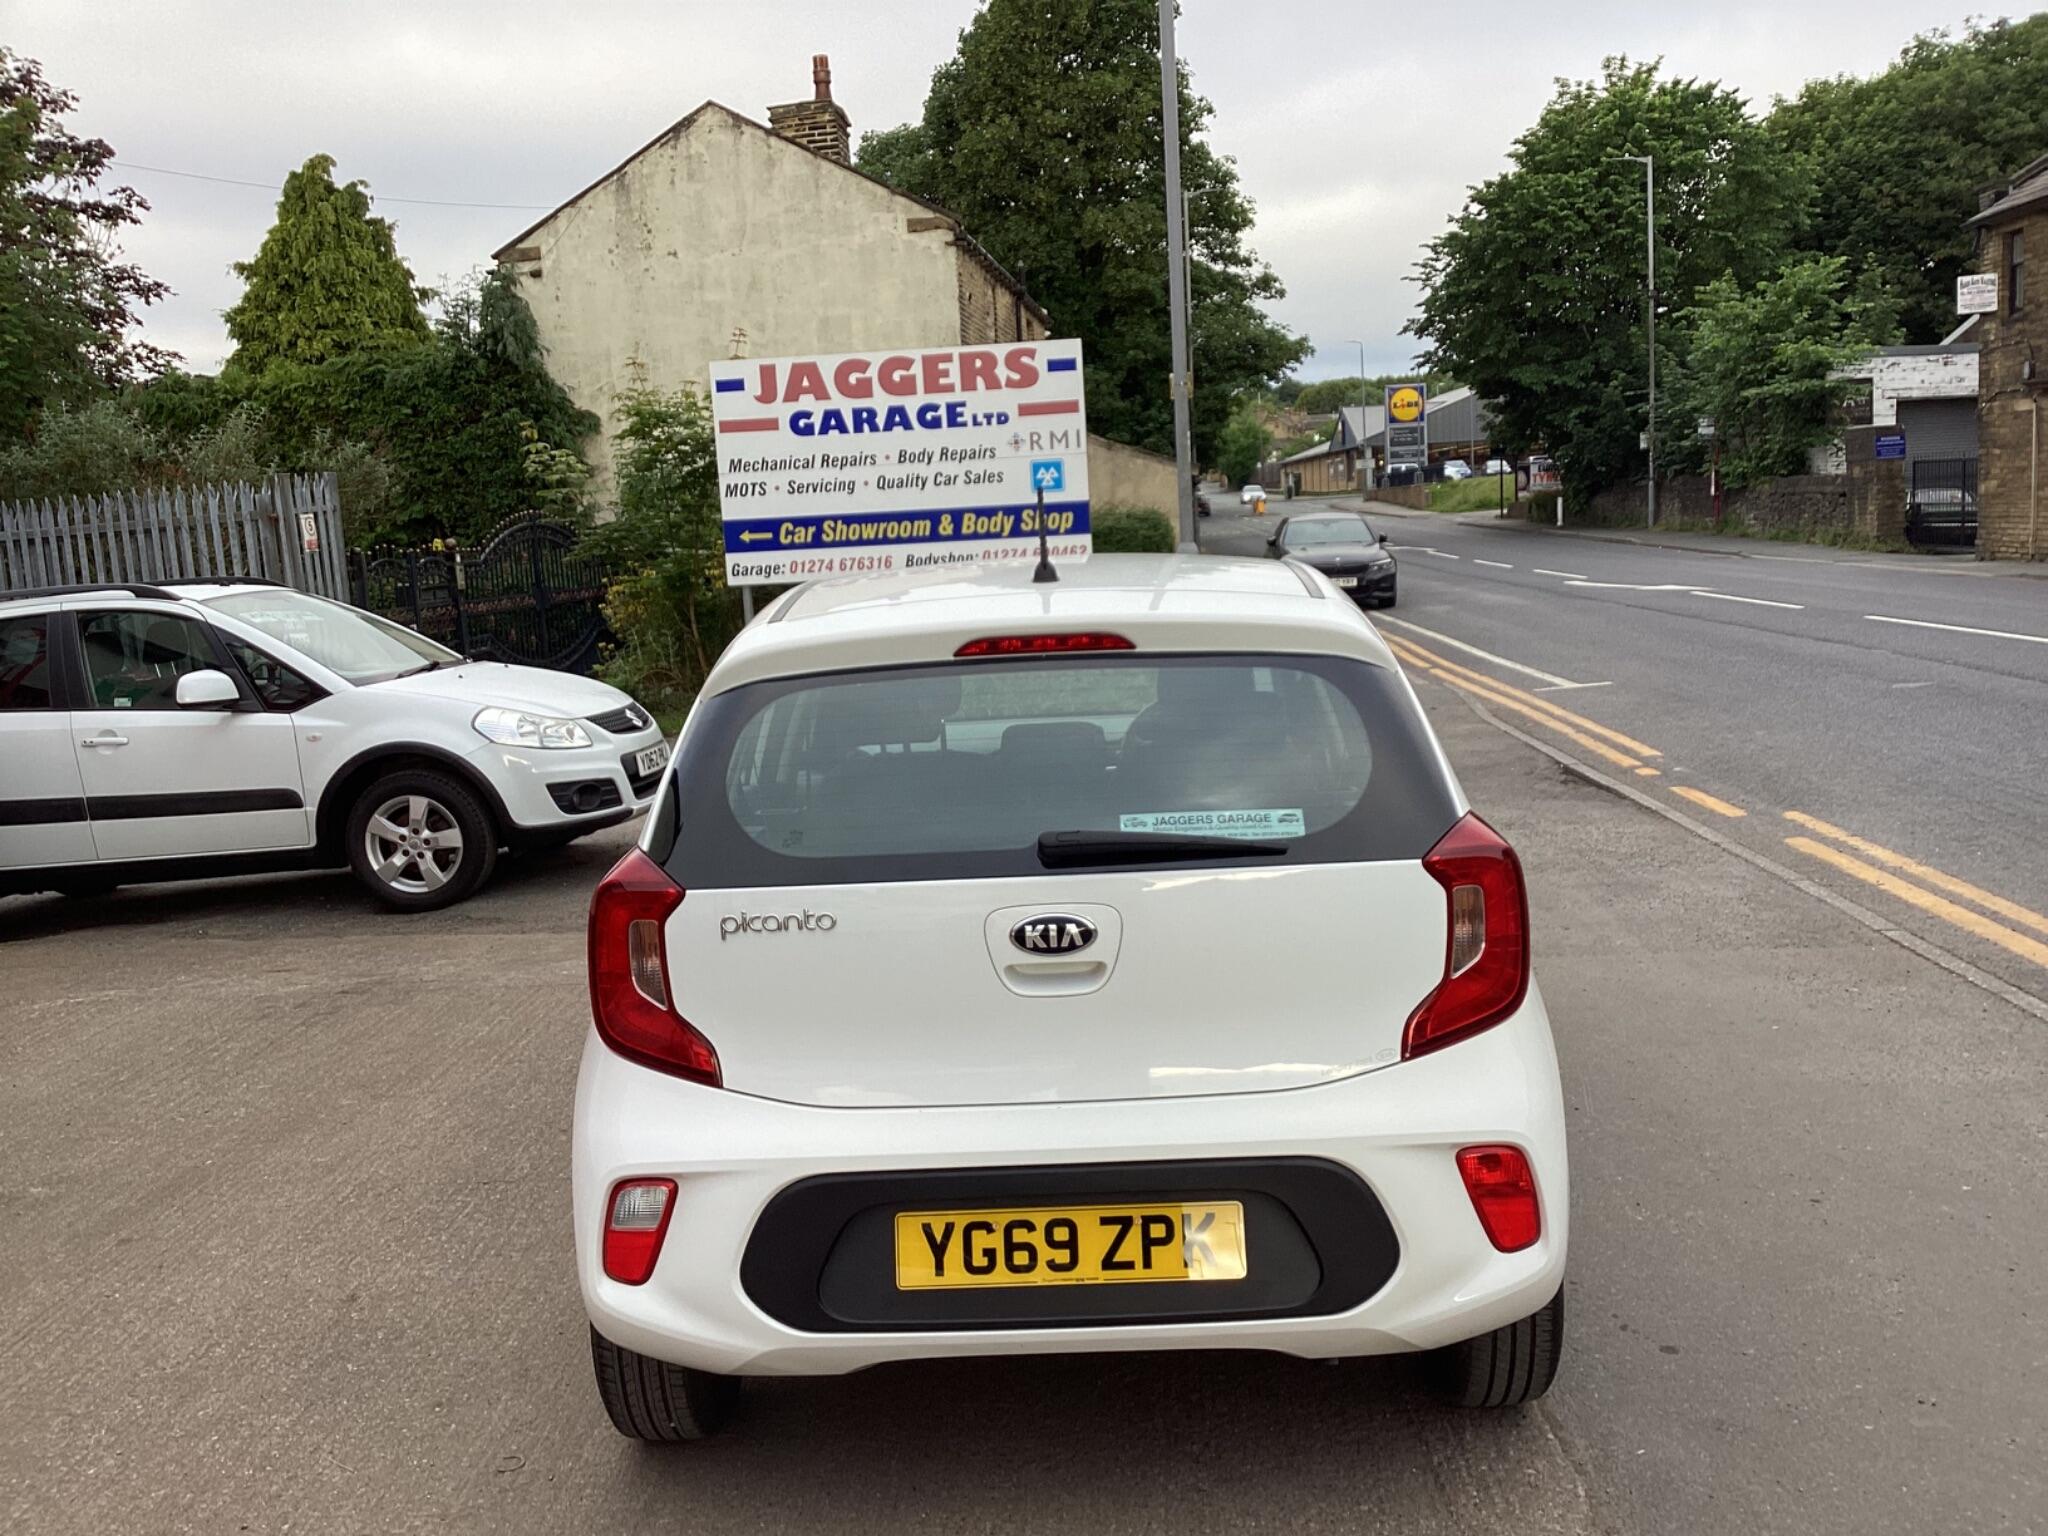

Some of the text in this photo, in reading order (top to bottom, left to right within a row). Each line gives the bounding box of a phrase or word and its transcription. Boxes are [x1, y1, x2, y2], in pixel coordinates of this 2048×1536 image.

[753, 347, 1040, 404] JAGGERS
[789, 401, 1010, 436] GARAGE LTD
[1030, 429, 1081, 450] RMI
[728, 444, 997, 473] Mechanical Repairs Body Repairs
[725, 469, 1004, 498] MOTS Servicing Quality Car Sales
[779, 508, 1074, 544] Car Showroom & Body Shop
[731, 562, 786, 578] Garage:
[790, 558, 834, 574] 01274
[839, 555, 892, 571] 676316
[1152, 813, 1272, 826] JAGGERS GARAGE
[720, 907, 837, 941] picanto
[1024, 923, 1084, 949] KIA
[921, 1212, 1217, 1277] YG69 ZPK
